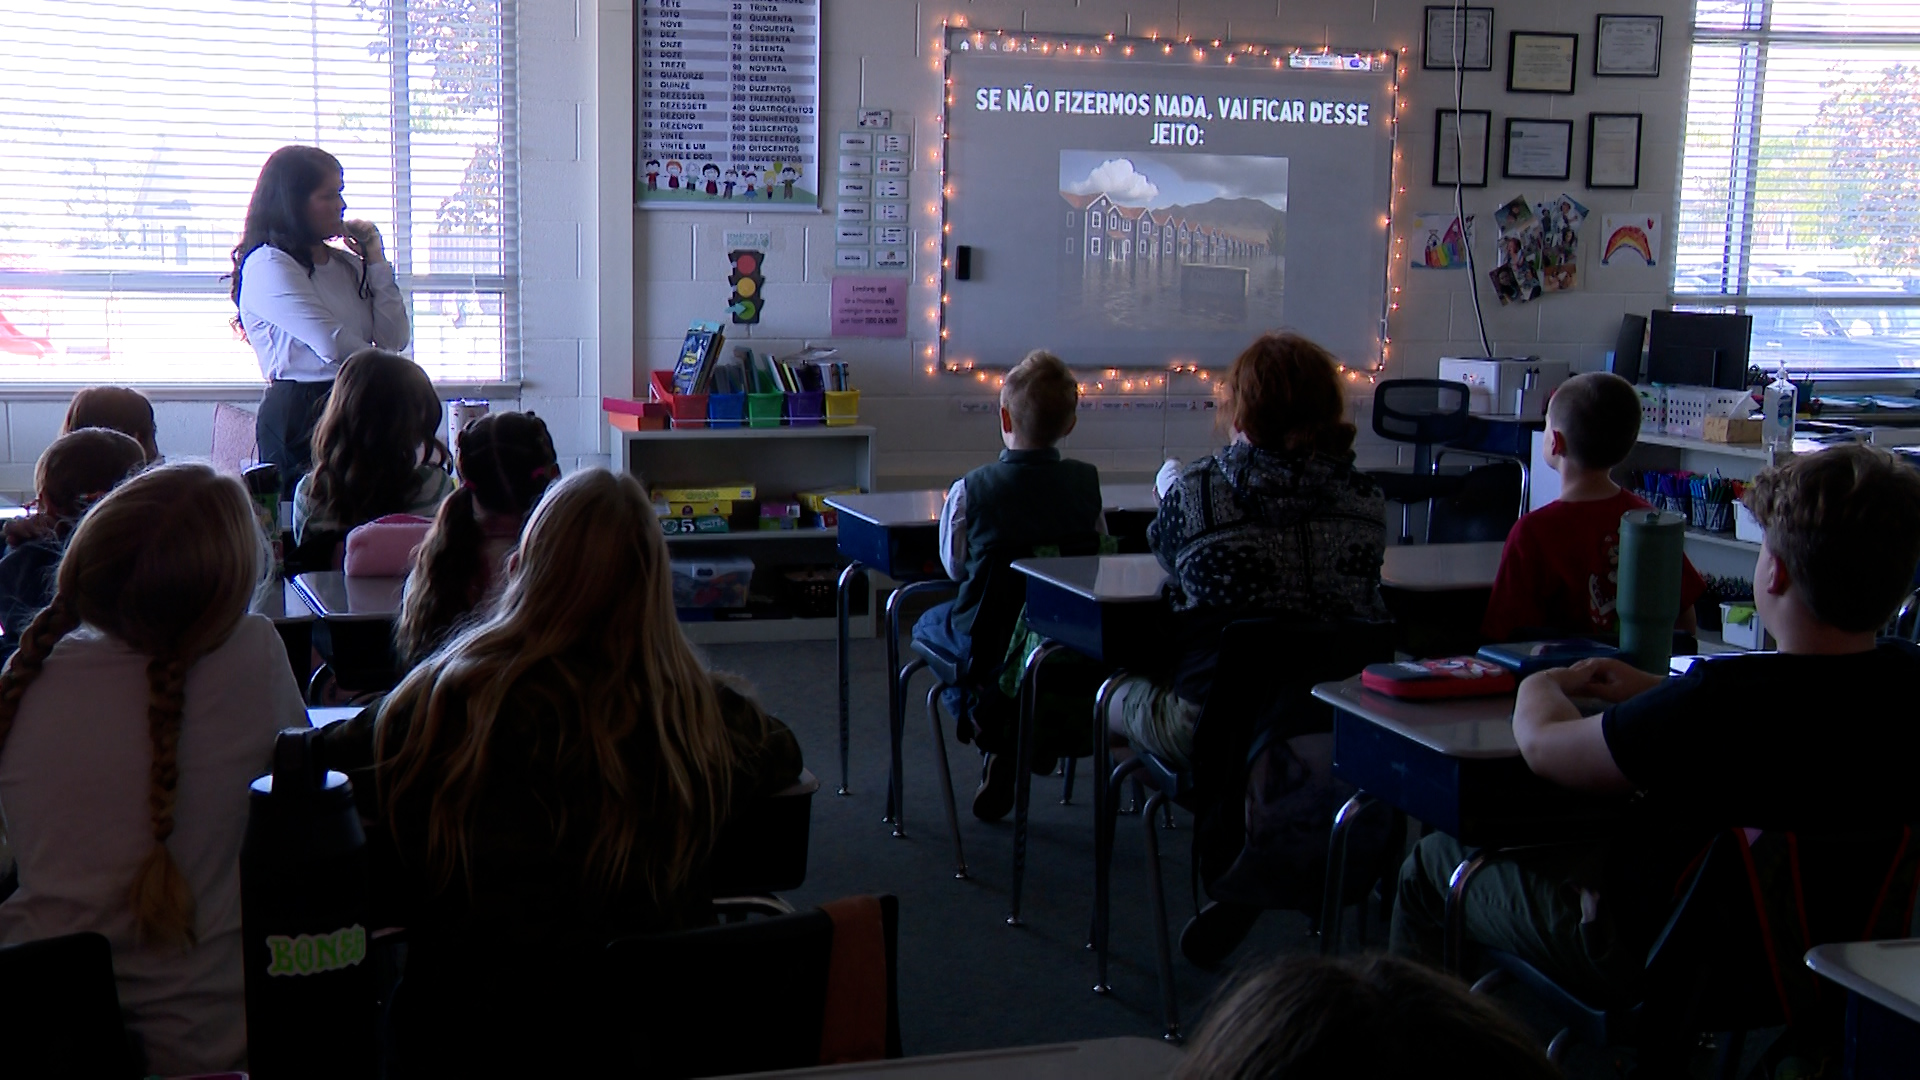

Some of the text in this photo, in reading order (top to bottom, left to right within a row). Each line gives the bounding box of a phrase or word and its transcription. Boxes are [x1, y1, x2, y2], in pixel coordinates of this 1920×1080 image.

[750, 4, 778, 12] TRINTA
[660, 10, 680, 18] OITO
[749, 14, 793, 22] QUARENTA
[749, 24, 795, 33] CINQUENTA
[749, 34, 791, 43] SESSENTA
[660, 51, 683, 59] DOZE
[749, 54, 784, 63] OITENTA
[660, 61, 686, 69] TREZE
[749, 65, 787, 73] NOVENTA
[660, 71, 704, 80] QUATORZE
[660, 81, 690, 90] QUINZE
[749, 85, 792, 94] DUZENTOS
[660, 92, 705, 100] DEZESSEIS
[749, 95, 796, 104] TREZENTOS
[660, 102, 707, 110] DEZESSETE
[976, 83, 1370, 126] SE NÃO FIZERMOS NADA, VAI FICAR DESSE
[748, 105, 814, 114] QUATROCENTOS
[660, 112, 696, 120] DEZOITO
[749, 115, 800, 124] QUINHENTOS
[660, 122, 704, 130] DEZENOVE
[749, 125, 799, 133] SEISCENTOS
[660, 132, 684, 140] VINTE
[1150, 122, 1205, 146] JEITO:
[748, 135, 801, 144] SETECENTOS
[748, 145, 799, 153] OITOCENTOS
[748, 155, 803, 164] NOVECENTOS
